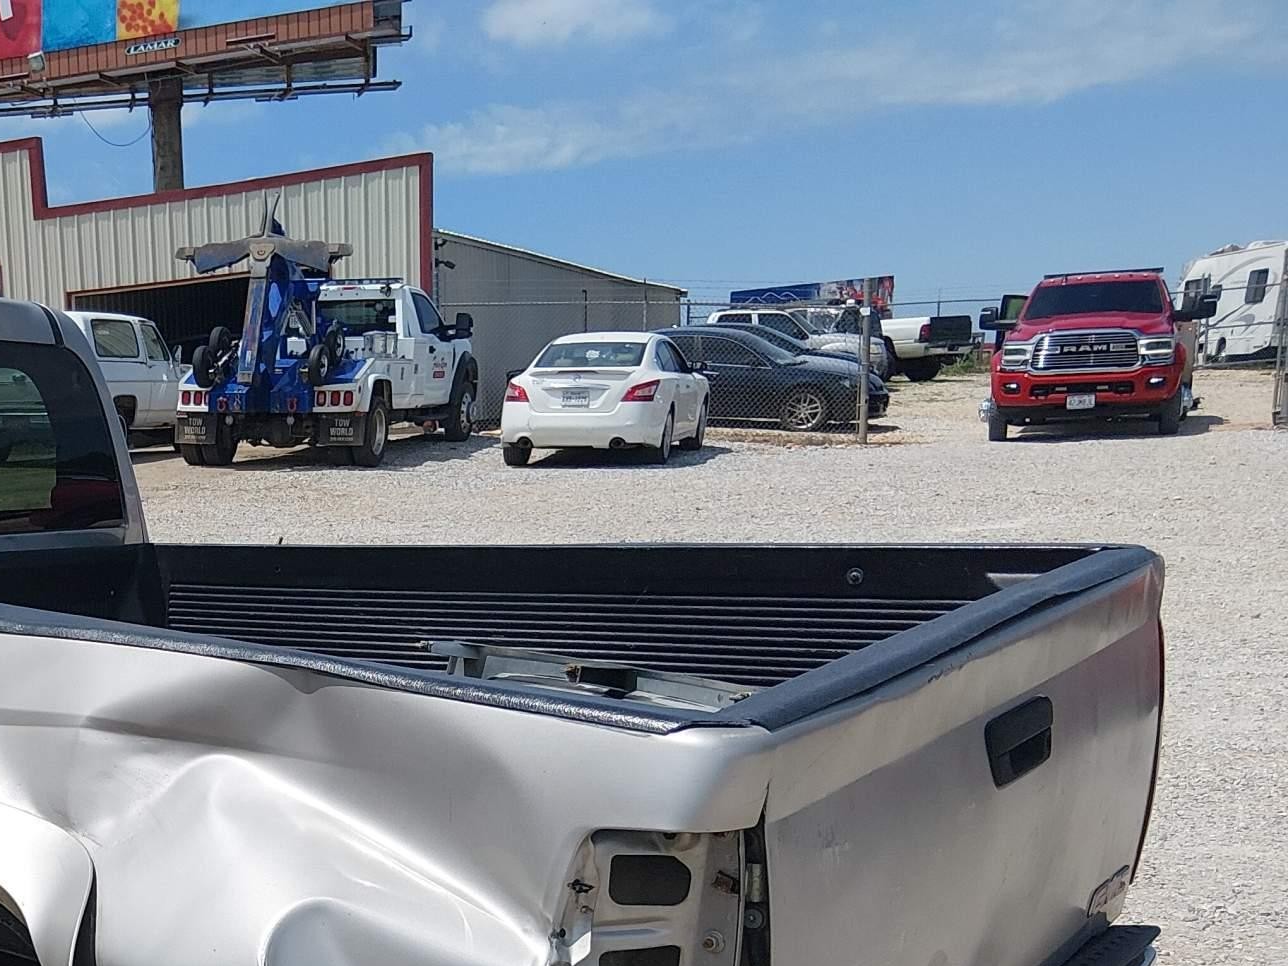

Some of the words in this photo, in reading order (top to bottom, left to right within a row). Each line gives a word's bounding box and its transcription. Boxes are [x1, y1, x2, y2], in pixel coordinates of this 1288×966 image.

[129, 39, 176, 53] LAMAR
[1063, 343, 1108, 352] RAM
[189, 417, 203, 426] TOW
[334, 418, 350, 427] TOW
[184, 426, 206, 435] WORLD
[329, 427, 354, 436] WORLD
